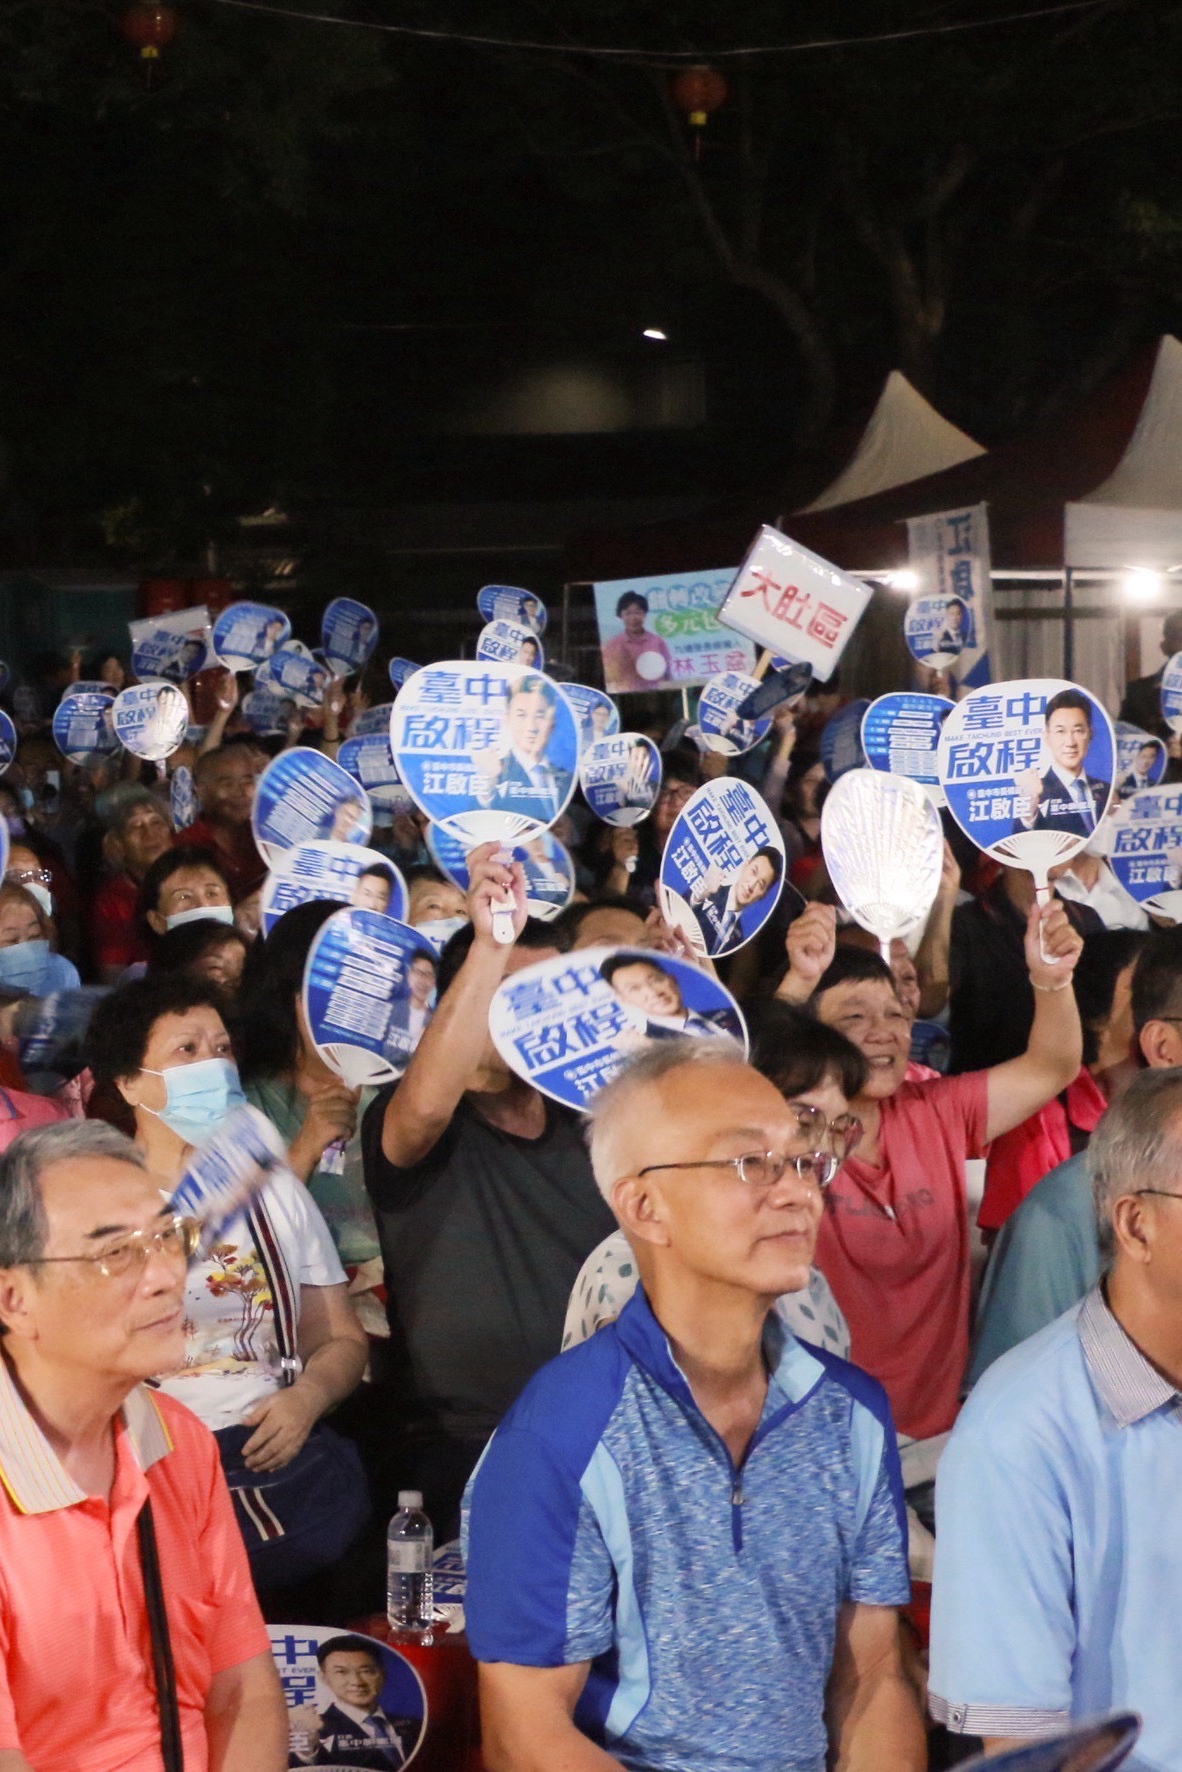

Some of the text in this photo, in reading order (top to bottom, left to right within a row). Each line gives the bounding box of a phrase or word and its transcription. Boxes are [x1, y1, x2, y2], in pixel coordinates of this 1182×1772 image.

[740, 570, 849, 650] 大肚區
[481, 637, 518, 659] 啟程
[494, 621, 526, 642] 臺中
[122, 687, 159, 706] 臺中
[419, 670, 510, 706] 臺中
[117, 706, 157, 726] 啟程
[962, 691, 1049, 732] 臺中
[401, 714, 501, 750] 啟程
[967, 731, 1002, 740] TAICHUNG
[1003, 729, 1022, 737] BEST
[1024, 727, 1044, 736] EVER
[585, 763, 628, 784] 啟程
[945, 737, 1043, 779] 啟程
[422, 772, 492, 797] 江啟臣
[720, 782, 772, 852] 臺中
[969, 795, 1033, 823] 江啟臣
[687, 797, 745, 874] 啟程
[290, 847, 367, 882] 臺中
[670, 844, 708, 899] 江啟臣
[502, 964, 605, 1022] 臺中
[513, 1000, 638, 1071] 啟程
